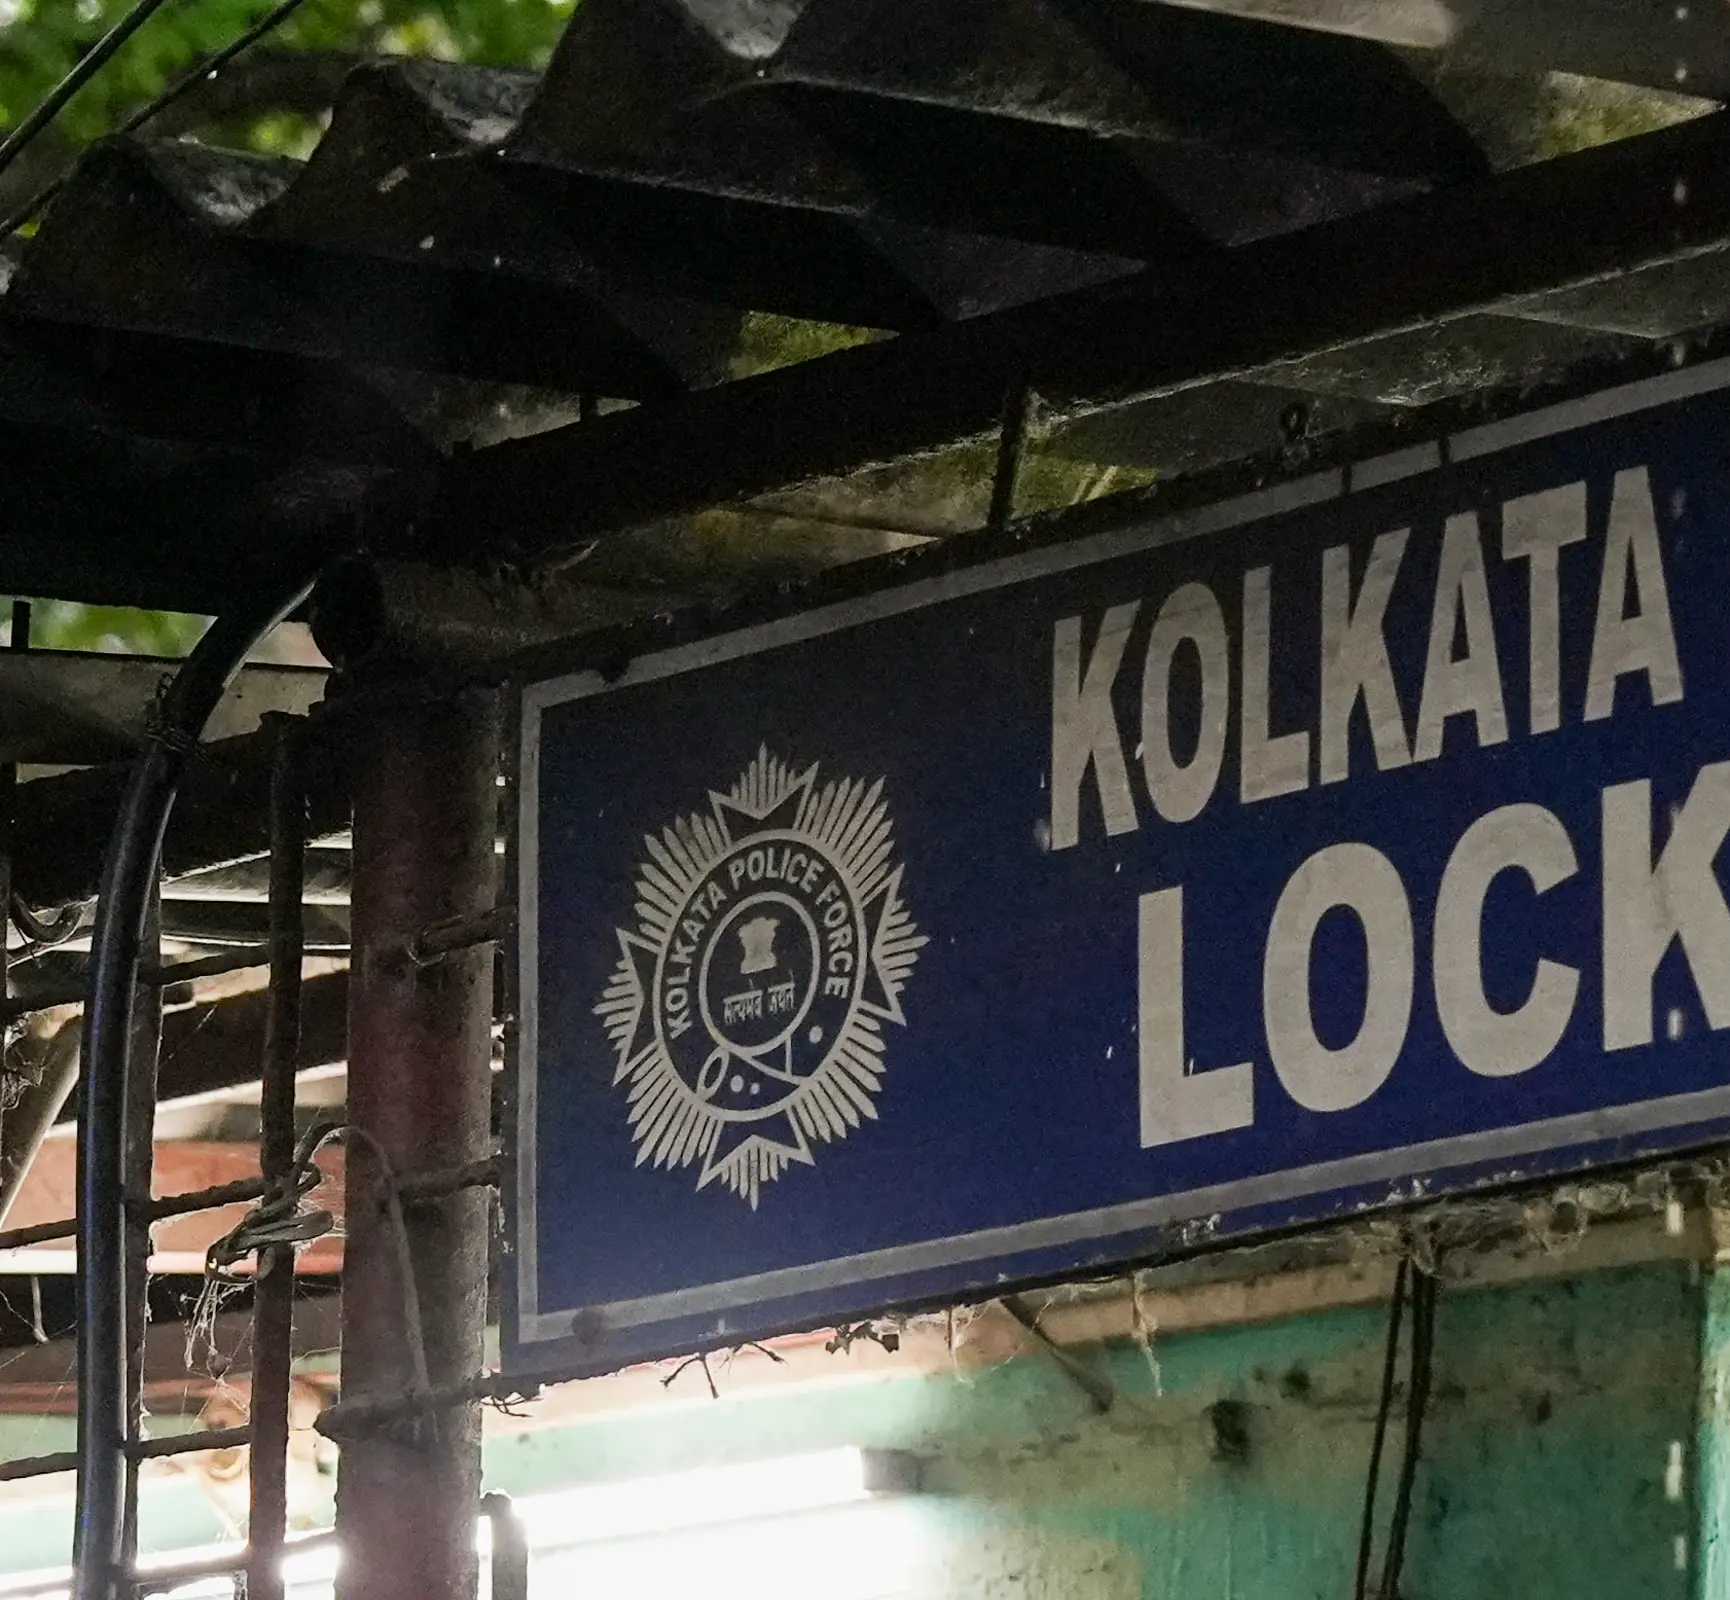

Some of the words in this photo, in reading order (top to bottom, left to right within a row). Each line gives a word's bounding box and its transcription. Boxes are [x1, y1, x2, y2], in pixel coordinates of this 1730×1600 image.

[1049, 465, 1684, 851] KOLKATA
[665, 880, 728, 1041] KOLKATA
[727, 847, 826, 894] POLICE
[814, 879, 854, 999] FORCE
